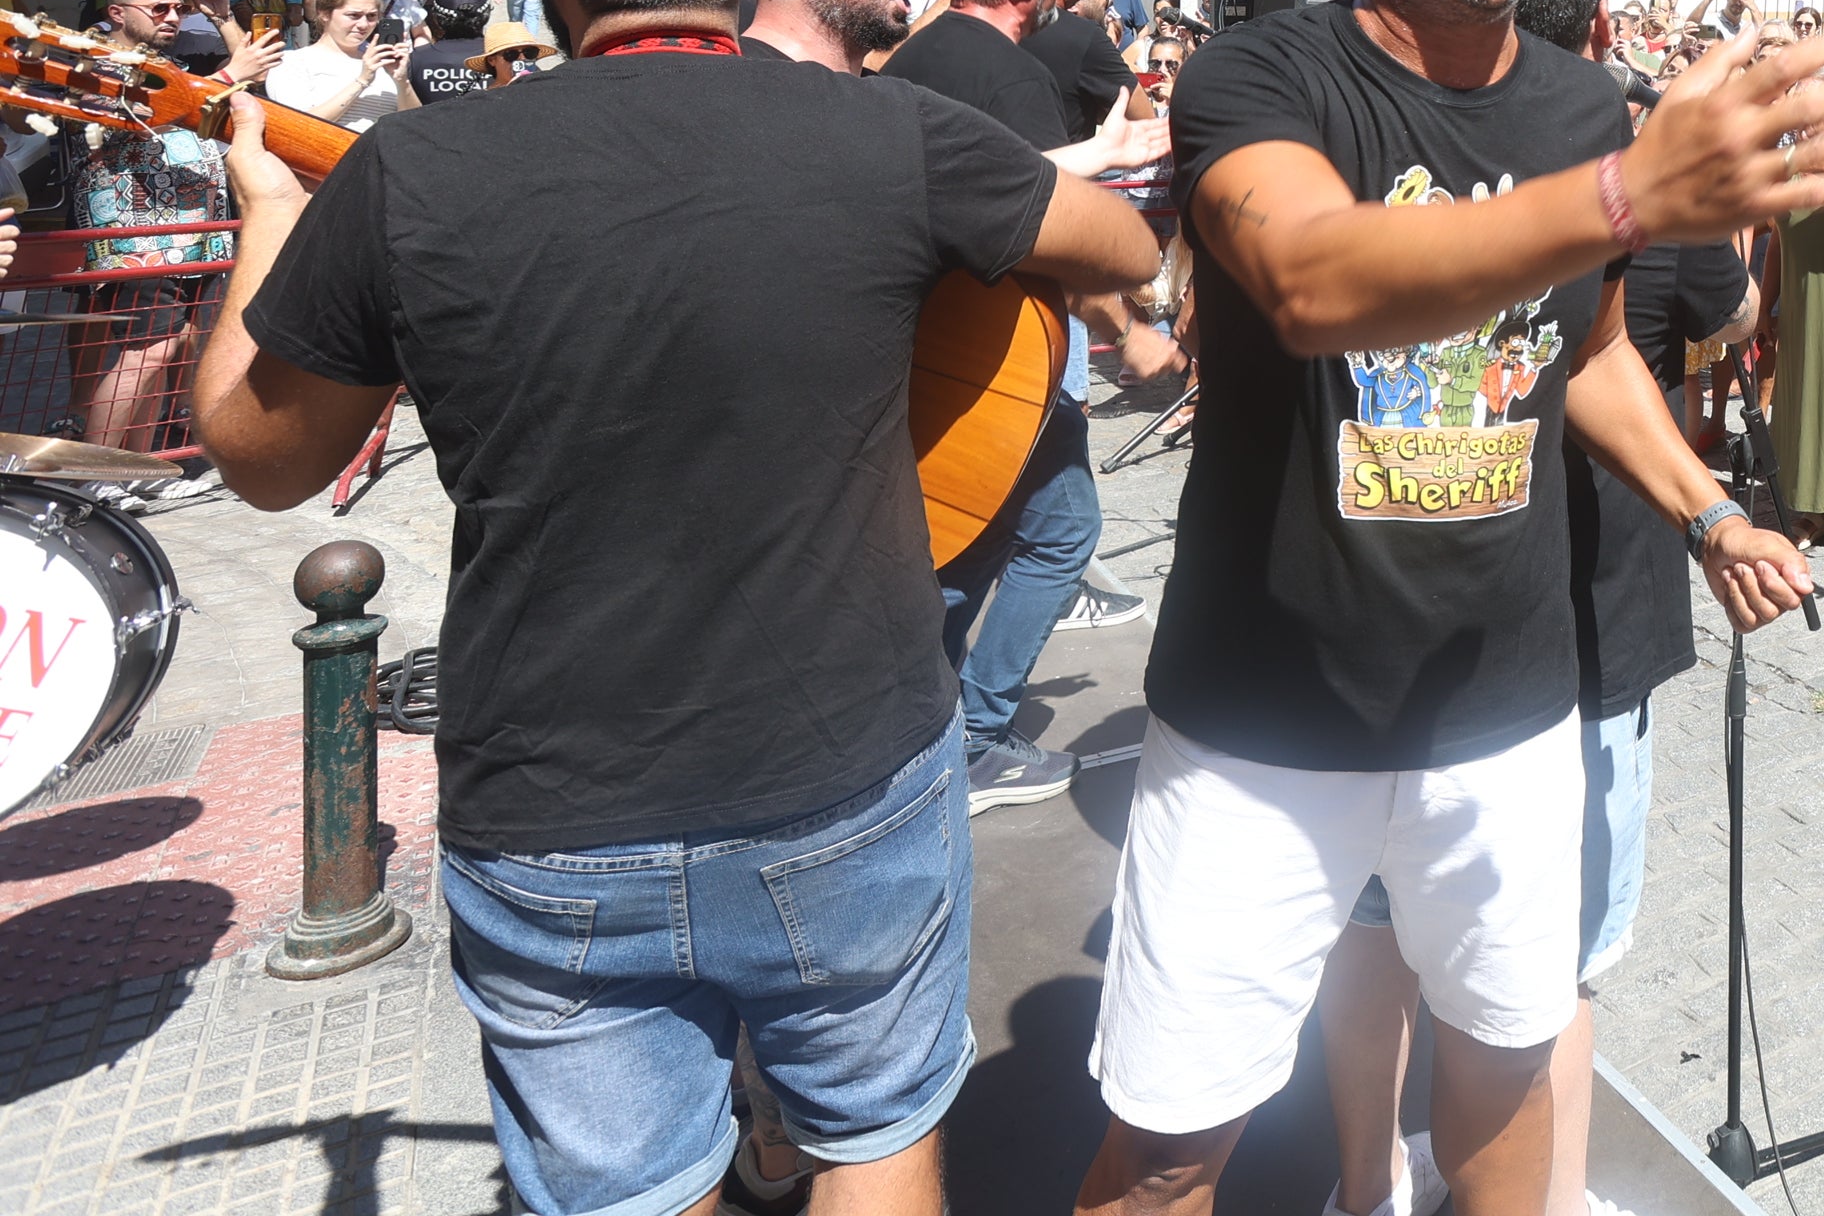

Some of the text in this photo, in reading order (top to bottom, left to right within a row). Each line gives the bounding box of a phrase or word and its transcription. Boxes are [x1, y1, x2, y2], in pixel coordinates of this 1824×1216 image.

[1358, 431, 1527, 460] Las Chirigotas
[1431, 456, 1465, 478] del
[1353, 455, 1524, 514] Sheriff
[0, 604, 87, 689] N
